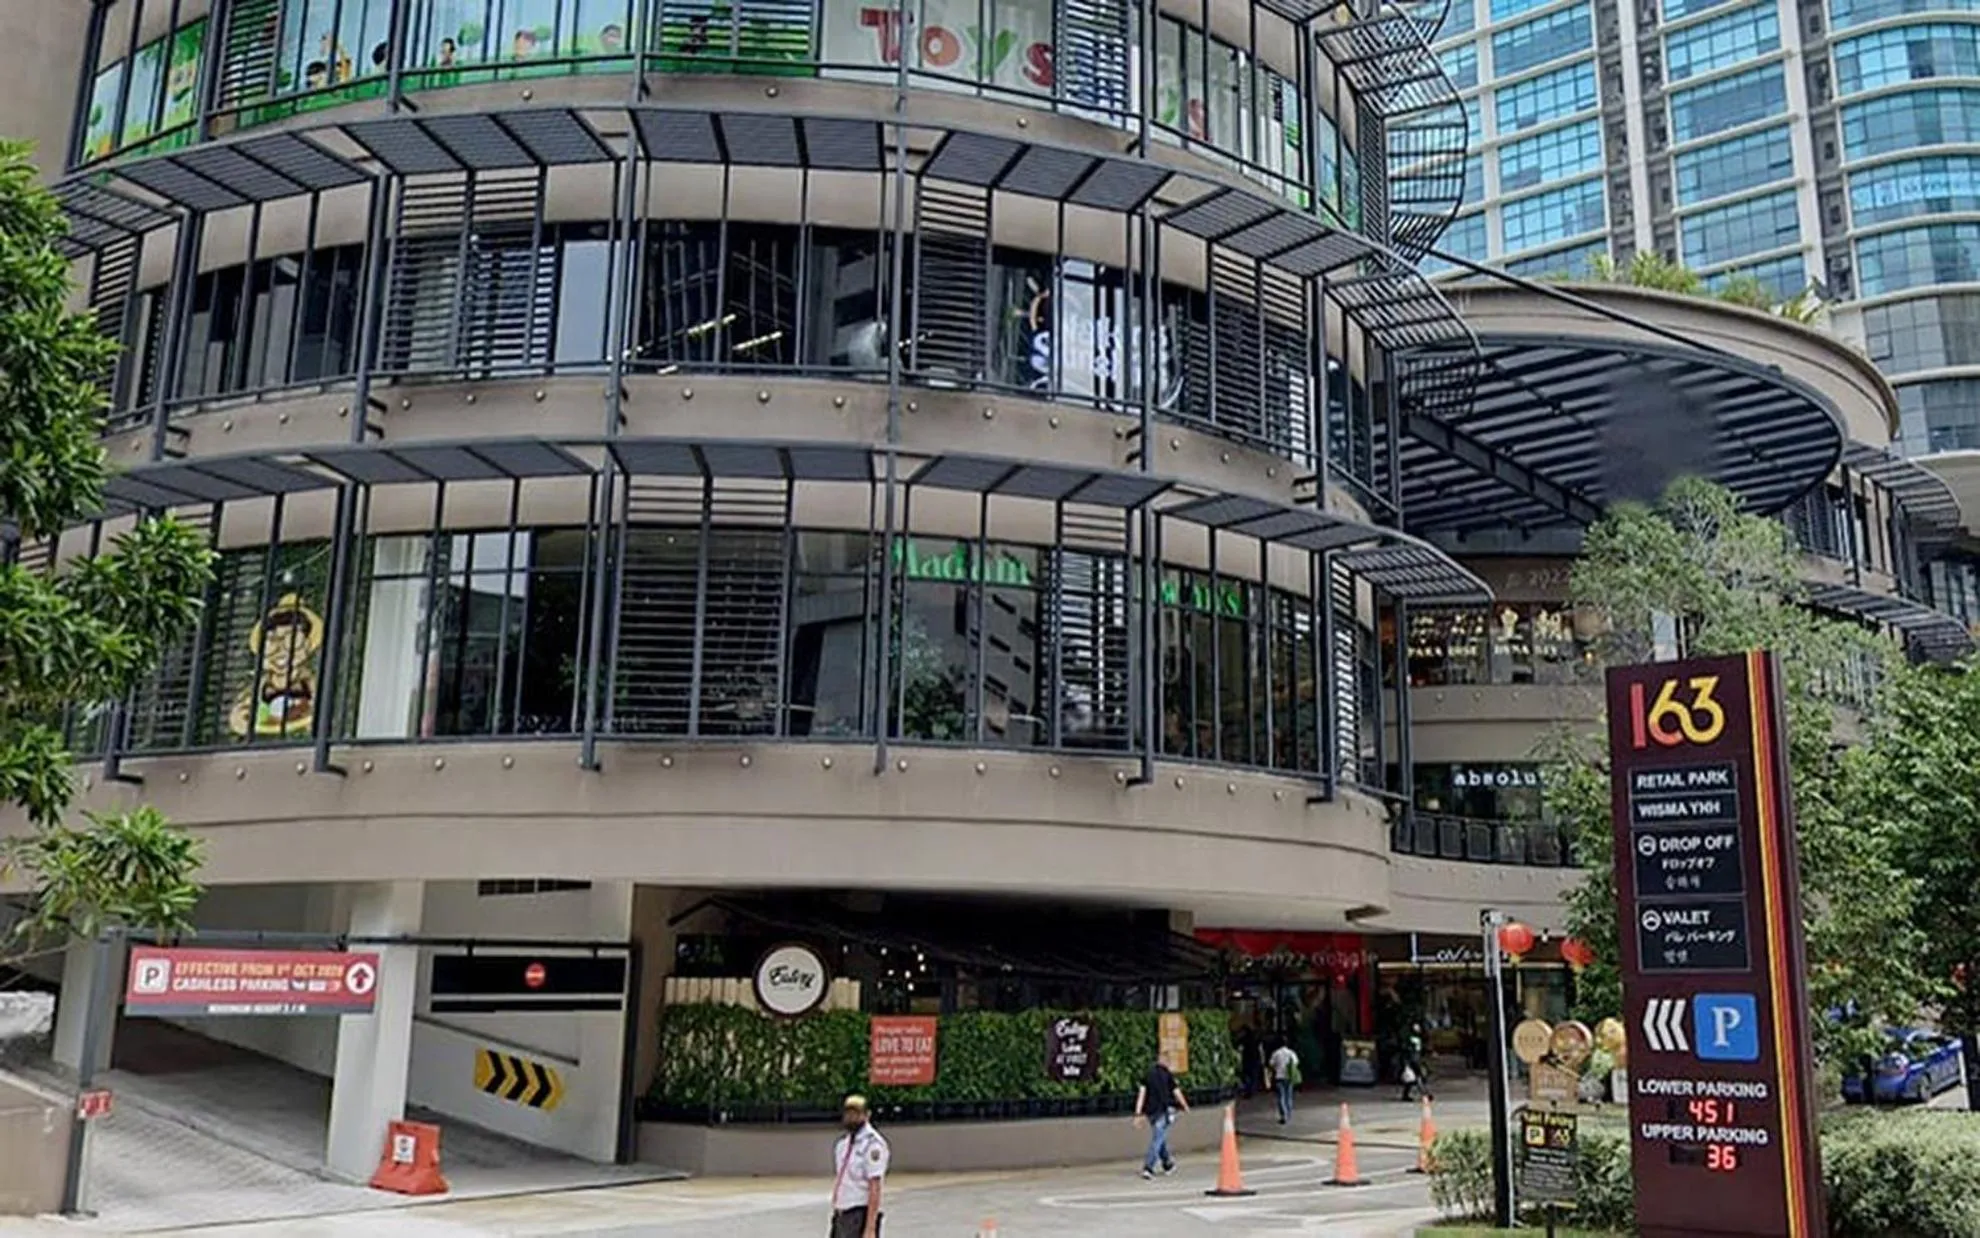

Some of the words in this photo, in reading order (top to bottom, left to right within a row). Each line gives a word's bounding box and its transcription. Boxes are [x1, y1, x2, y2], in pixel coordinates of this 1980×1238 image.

[1630, 676, 1725, 748] 163
[1636, 773, 1685, 789] RETAIL
[1688, 769, 1728, 785] PARK
[1638, 801, 1688, 817] WISMA
[1659, 836, 1700, 852] DROP
[1704, 834, 1734, 850] OFF
[1662, 910, 1710, 925] VALET
[145, 966, 160, 984] P
[175, 961, 237, 976] EFFECTIVE
[239, 962, 275, 977] FROM
[769, 964, 816, 992] Eatery
[172, 977, 237, 992] CASHLESS
[239, 978, 290, 992] PARKING
[1711, 1006, 1741, 1048] P
[1638, 1078, 1693, 1096] LOWER
[1696, 1081, 1768, 1098] PARKING
[1689, 1100, 1734, 1123] 451
[1642, 1123, 1694, 1141] UPPER
[1697, 1125, 1768, 1144] PARKING
[1707, 1145, 1736, 1169] 36
